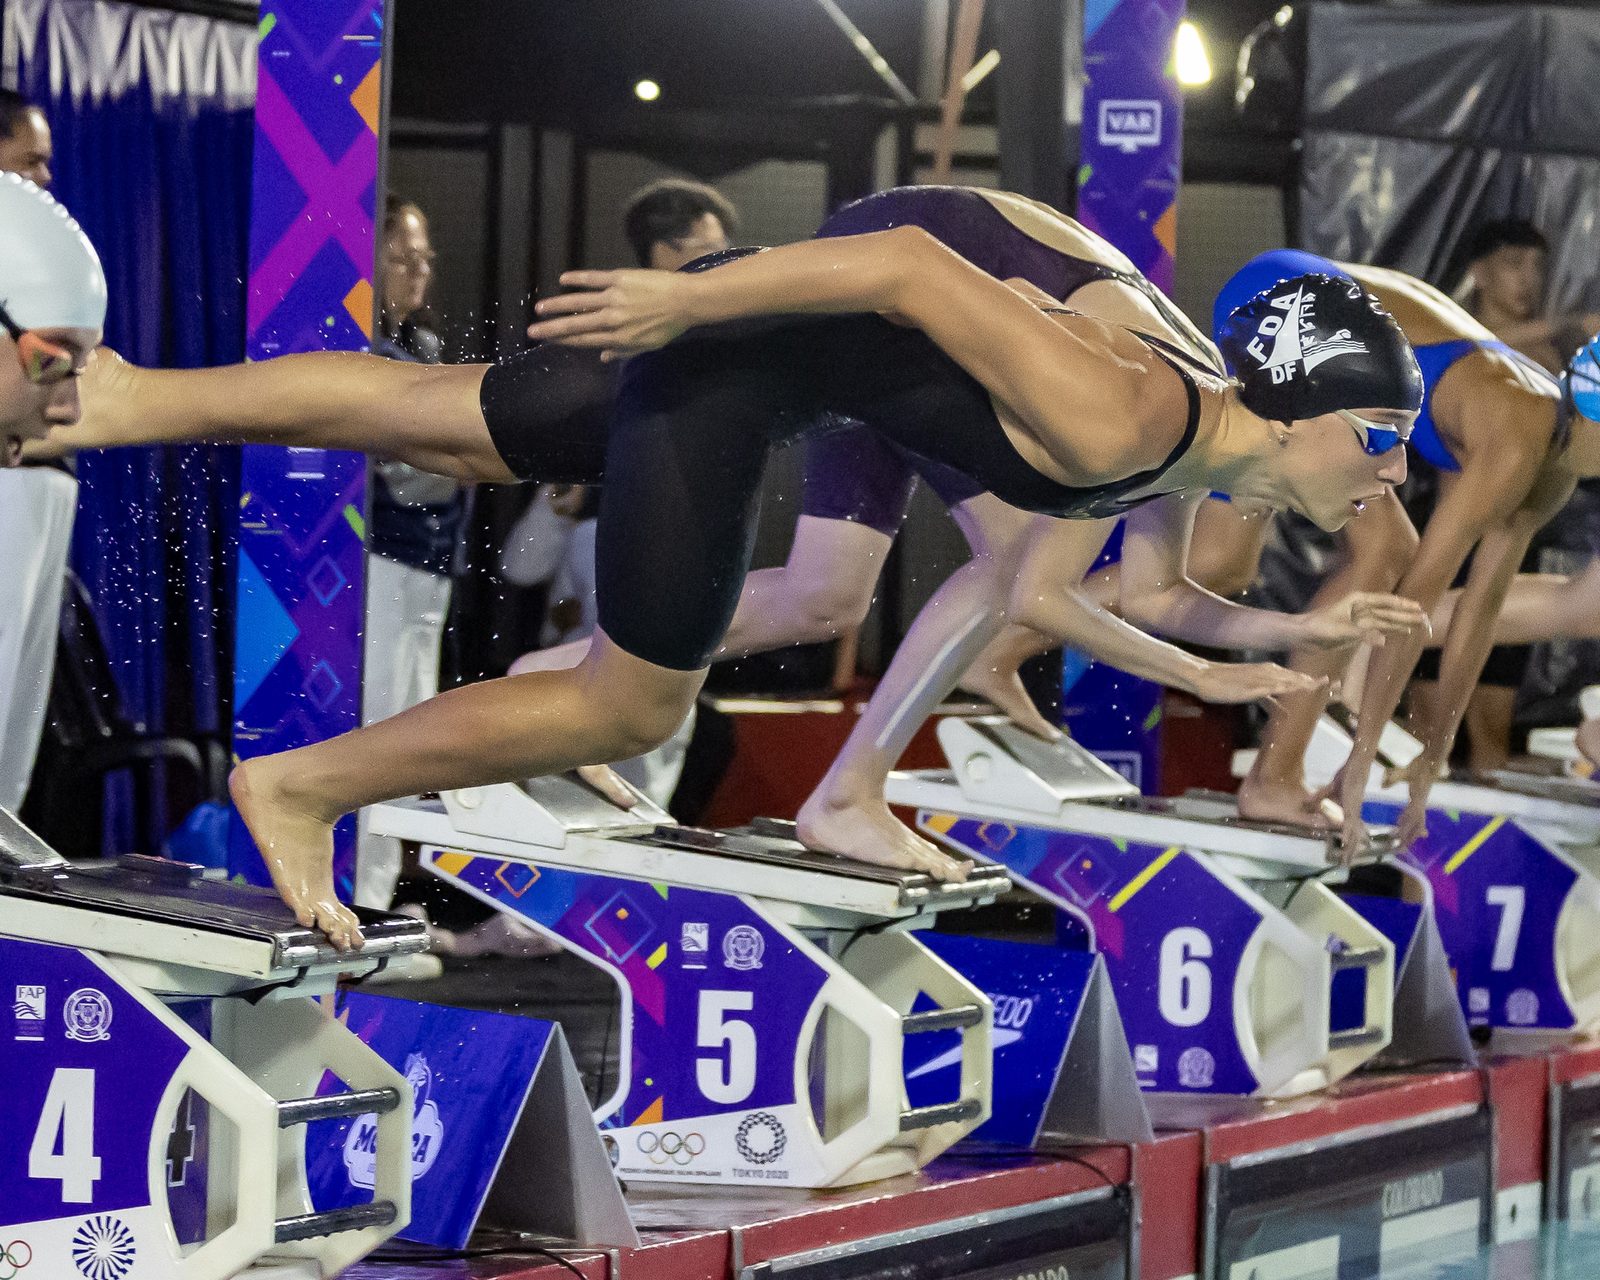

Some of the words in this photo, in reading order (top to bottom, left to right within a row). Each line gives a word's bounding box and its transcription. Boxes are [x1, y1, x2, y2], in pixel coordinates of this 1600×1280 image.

[1246, 292, 1298, 363] FDA
[1270, 361, 1297, 384] DF
[1486, 886, 1525, 971] 7
[18, 986, 45, 999] FAP
[1158, 926, 1213, 1027] 6
[695, 990, 757, 1104] 5
[28, 1068, 101, 1203] 4
[732, 1168, 763, 1178] TOKYO
[765, 1169, 789, 1179] 2020
